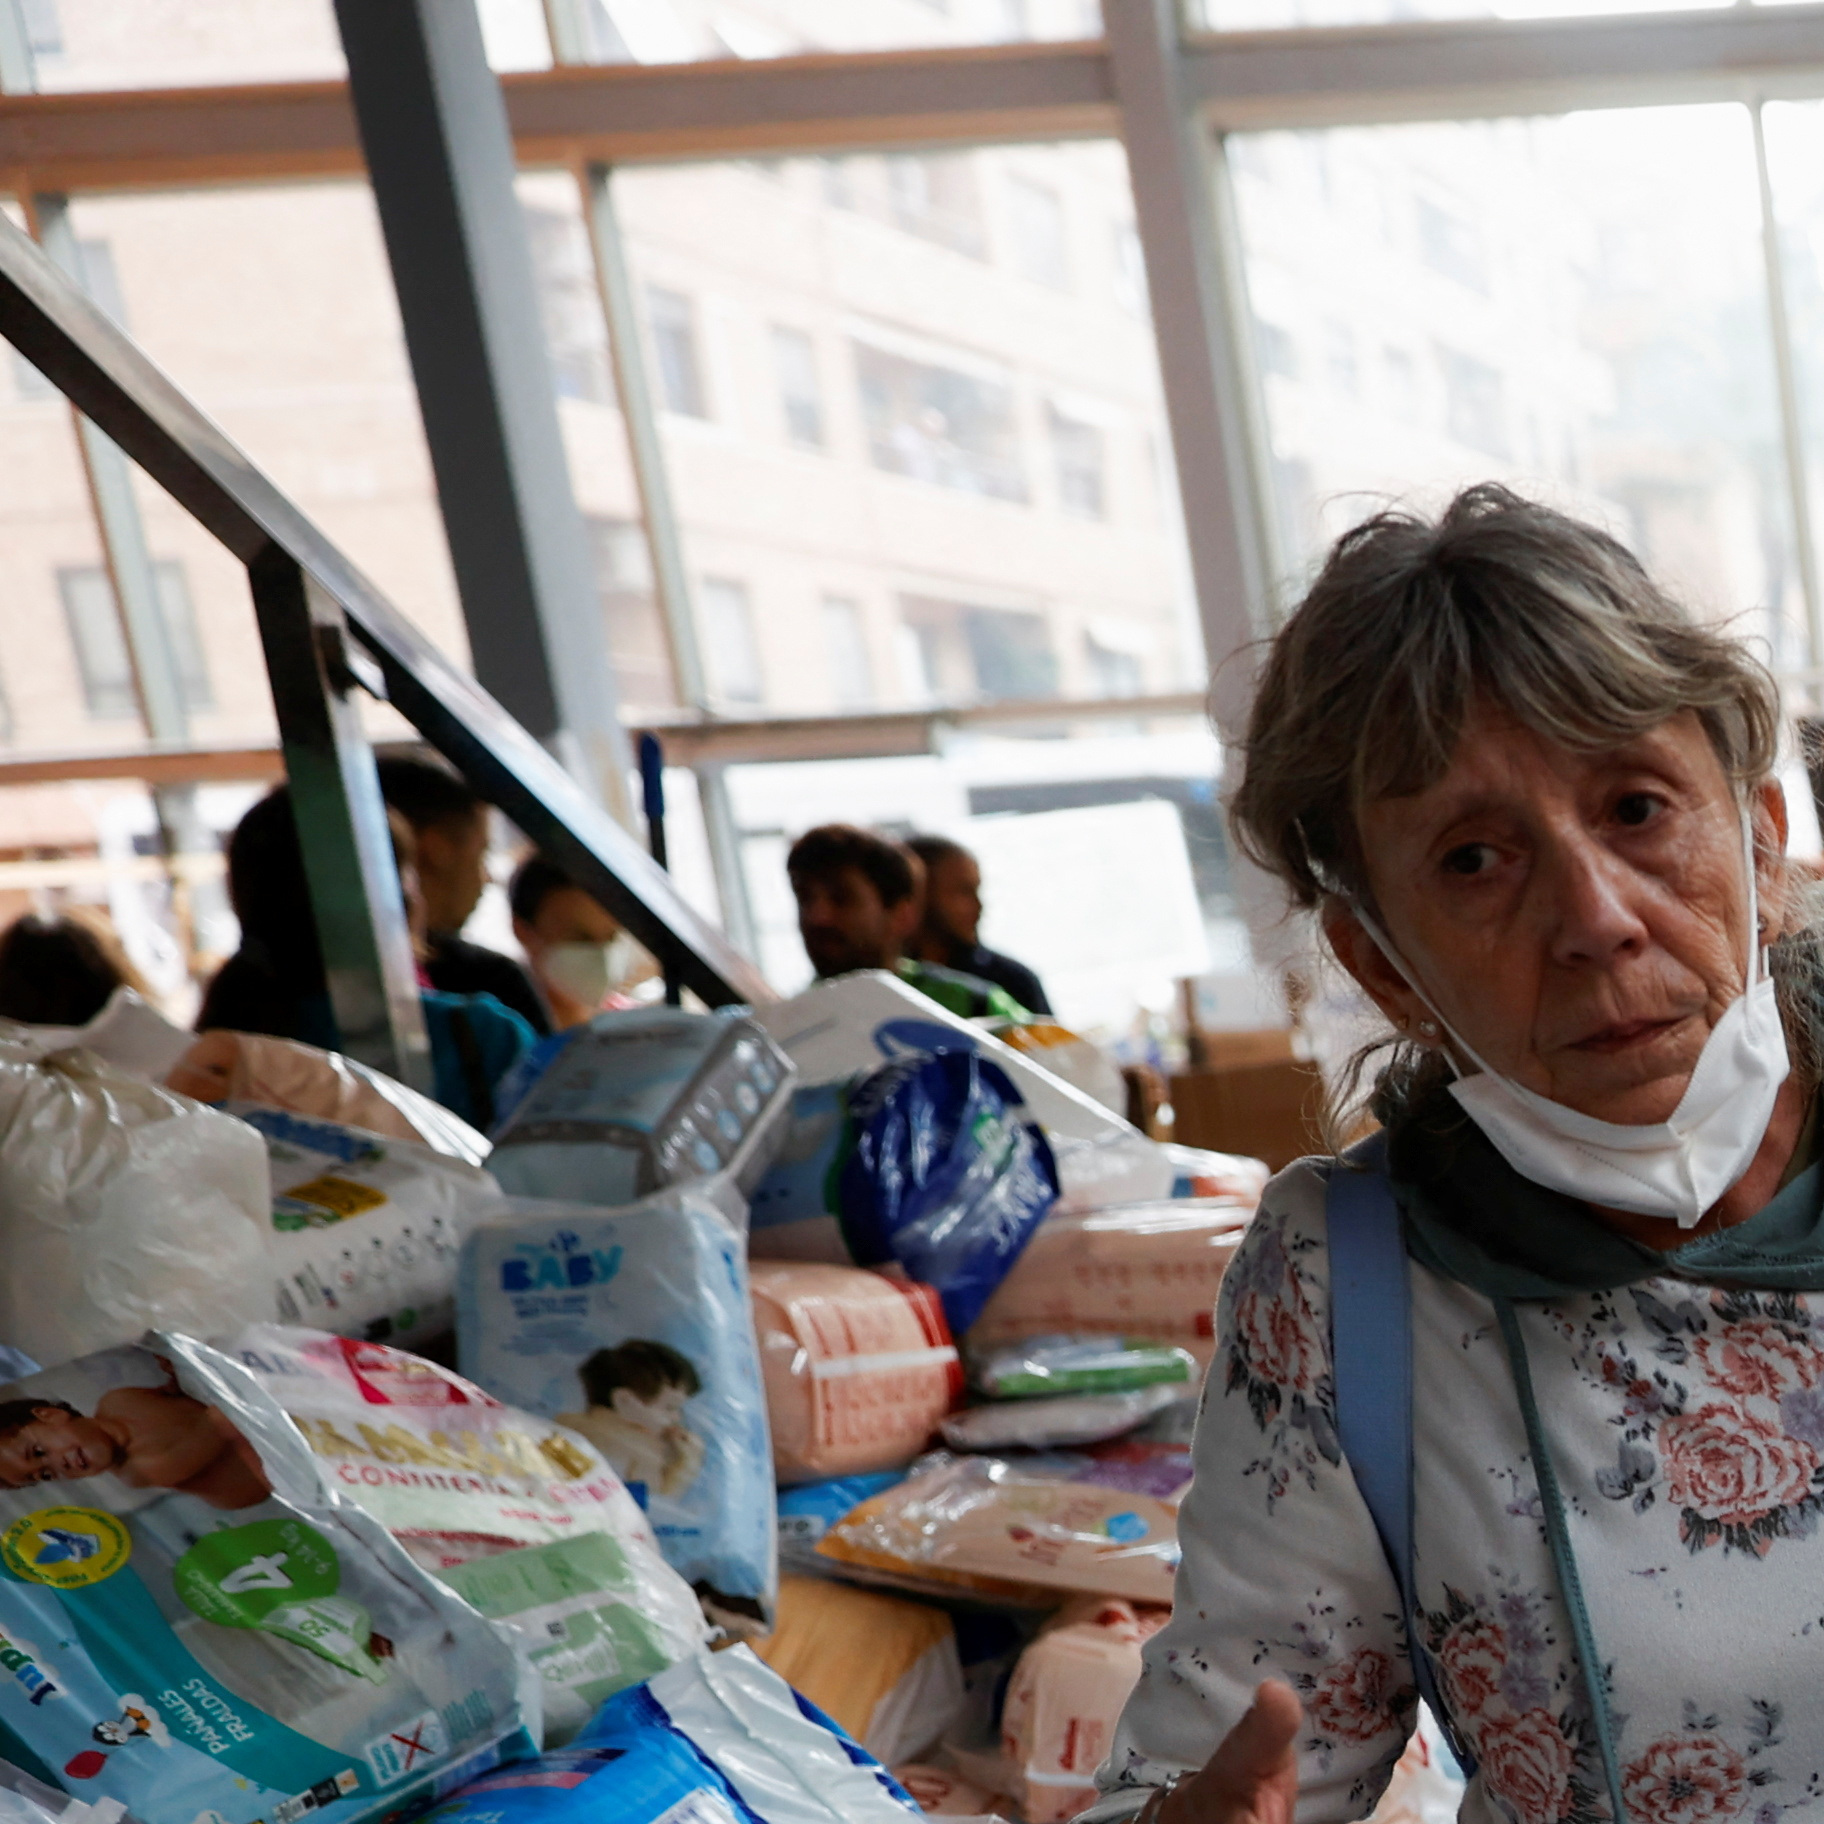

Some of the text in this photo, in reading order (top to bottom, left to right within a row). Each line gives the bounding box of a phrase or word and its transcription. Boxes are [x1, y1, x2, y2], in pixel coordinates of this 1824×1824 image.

[502, 1246, 624, 1292] BABY
[220, 1551, 294, 1594] 4
[158, 1688, 231, 1755] PAÑALES
[181, 1678, 256, 1743] FRALDAS
